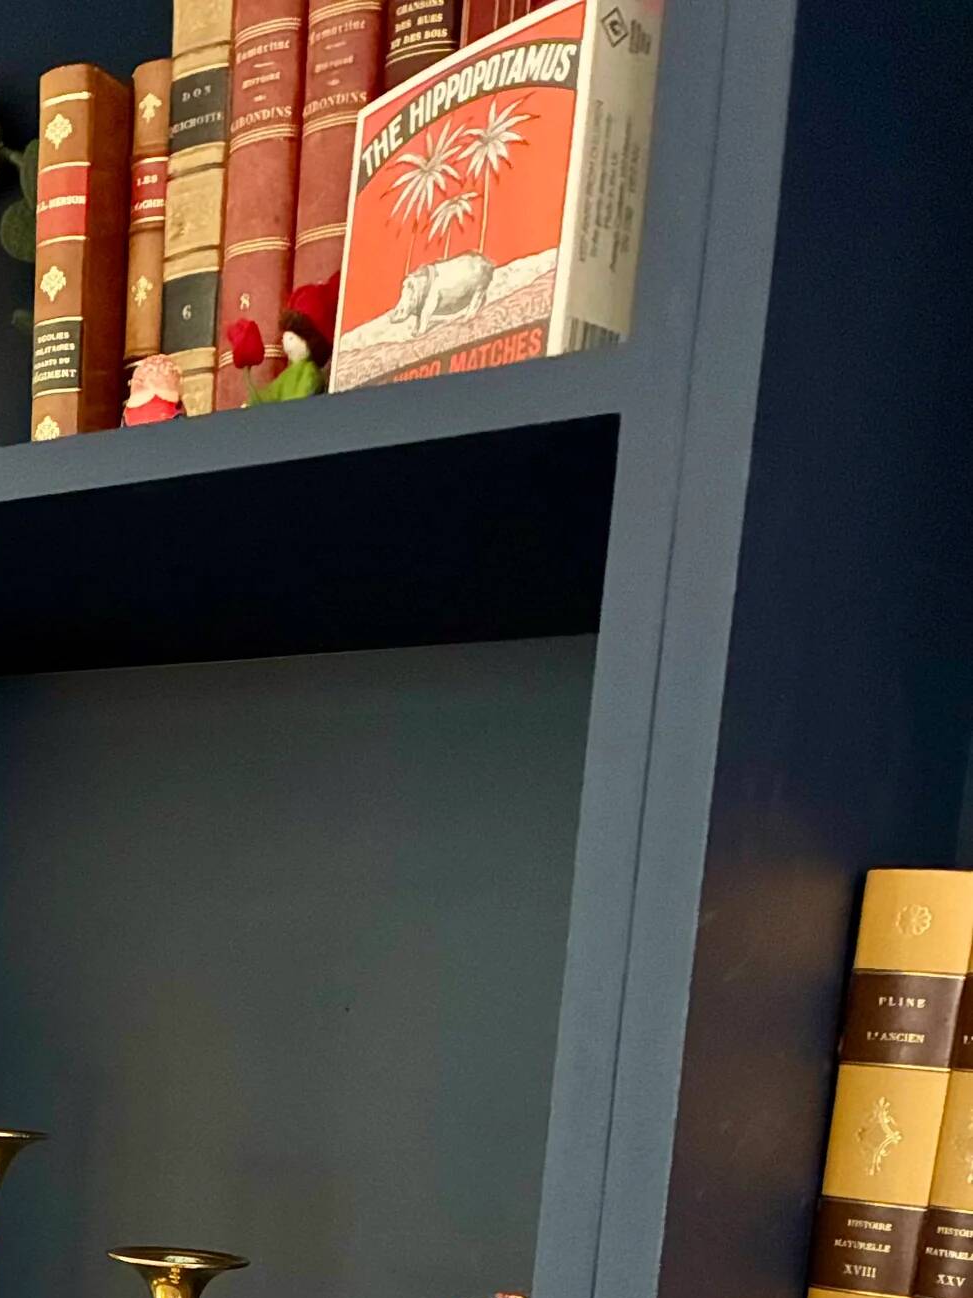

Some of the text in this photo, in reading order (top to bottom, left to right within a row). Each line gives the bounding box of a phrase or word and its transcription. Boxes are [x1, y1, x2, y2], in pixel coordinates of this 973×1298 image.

[424, 28, 448, 40] BOIS
[361, 43, 577, 177] THE HIPPOPOTAMUS
[181, 304, 192, 320] 6
[449, 328, 543, 374] MATCHES
[878, 996, 927, 1009] PLINE
[847, 1219, 893, 1232] HISTOIRE
[834, 1238, 891, 1254] NATURELLE
[936, 1274, 966, 1288] XXV
